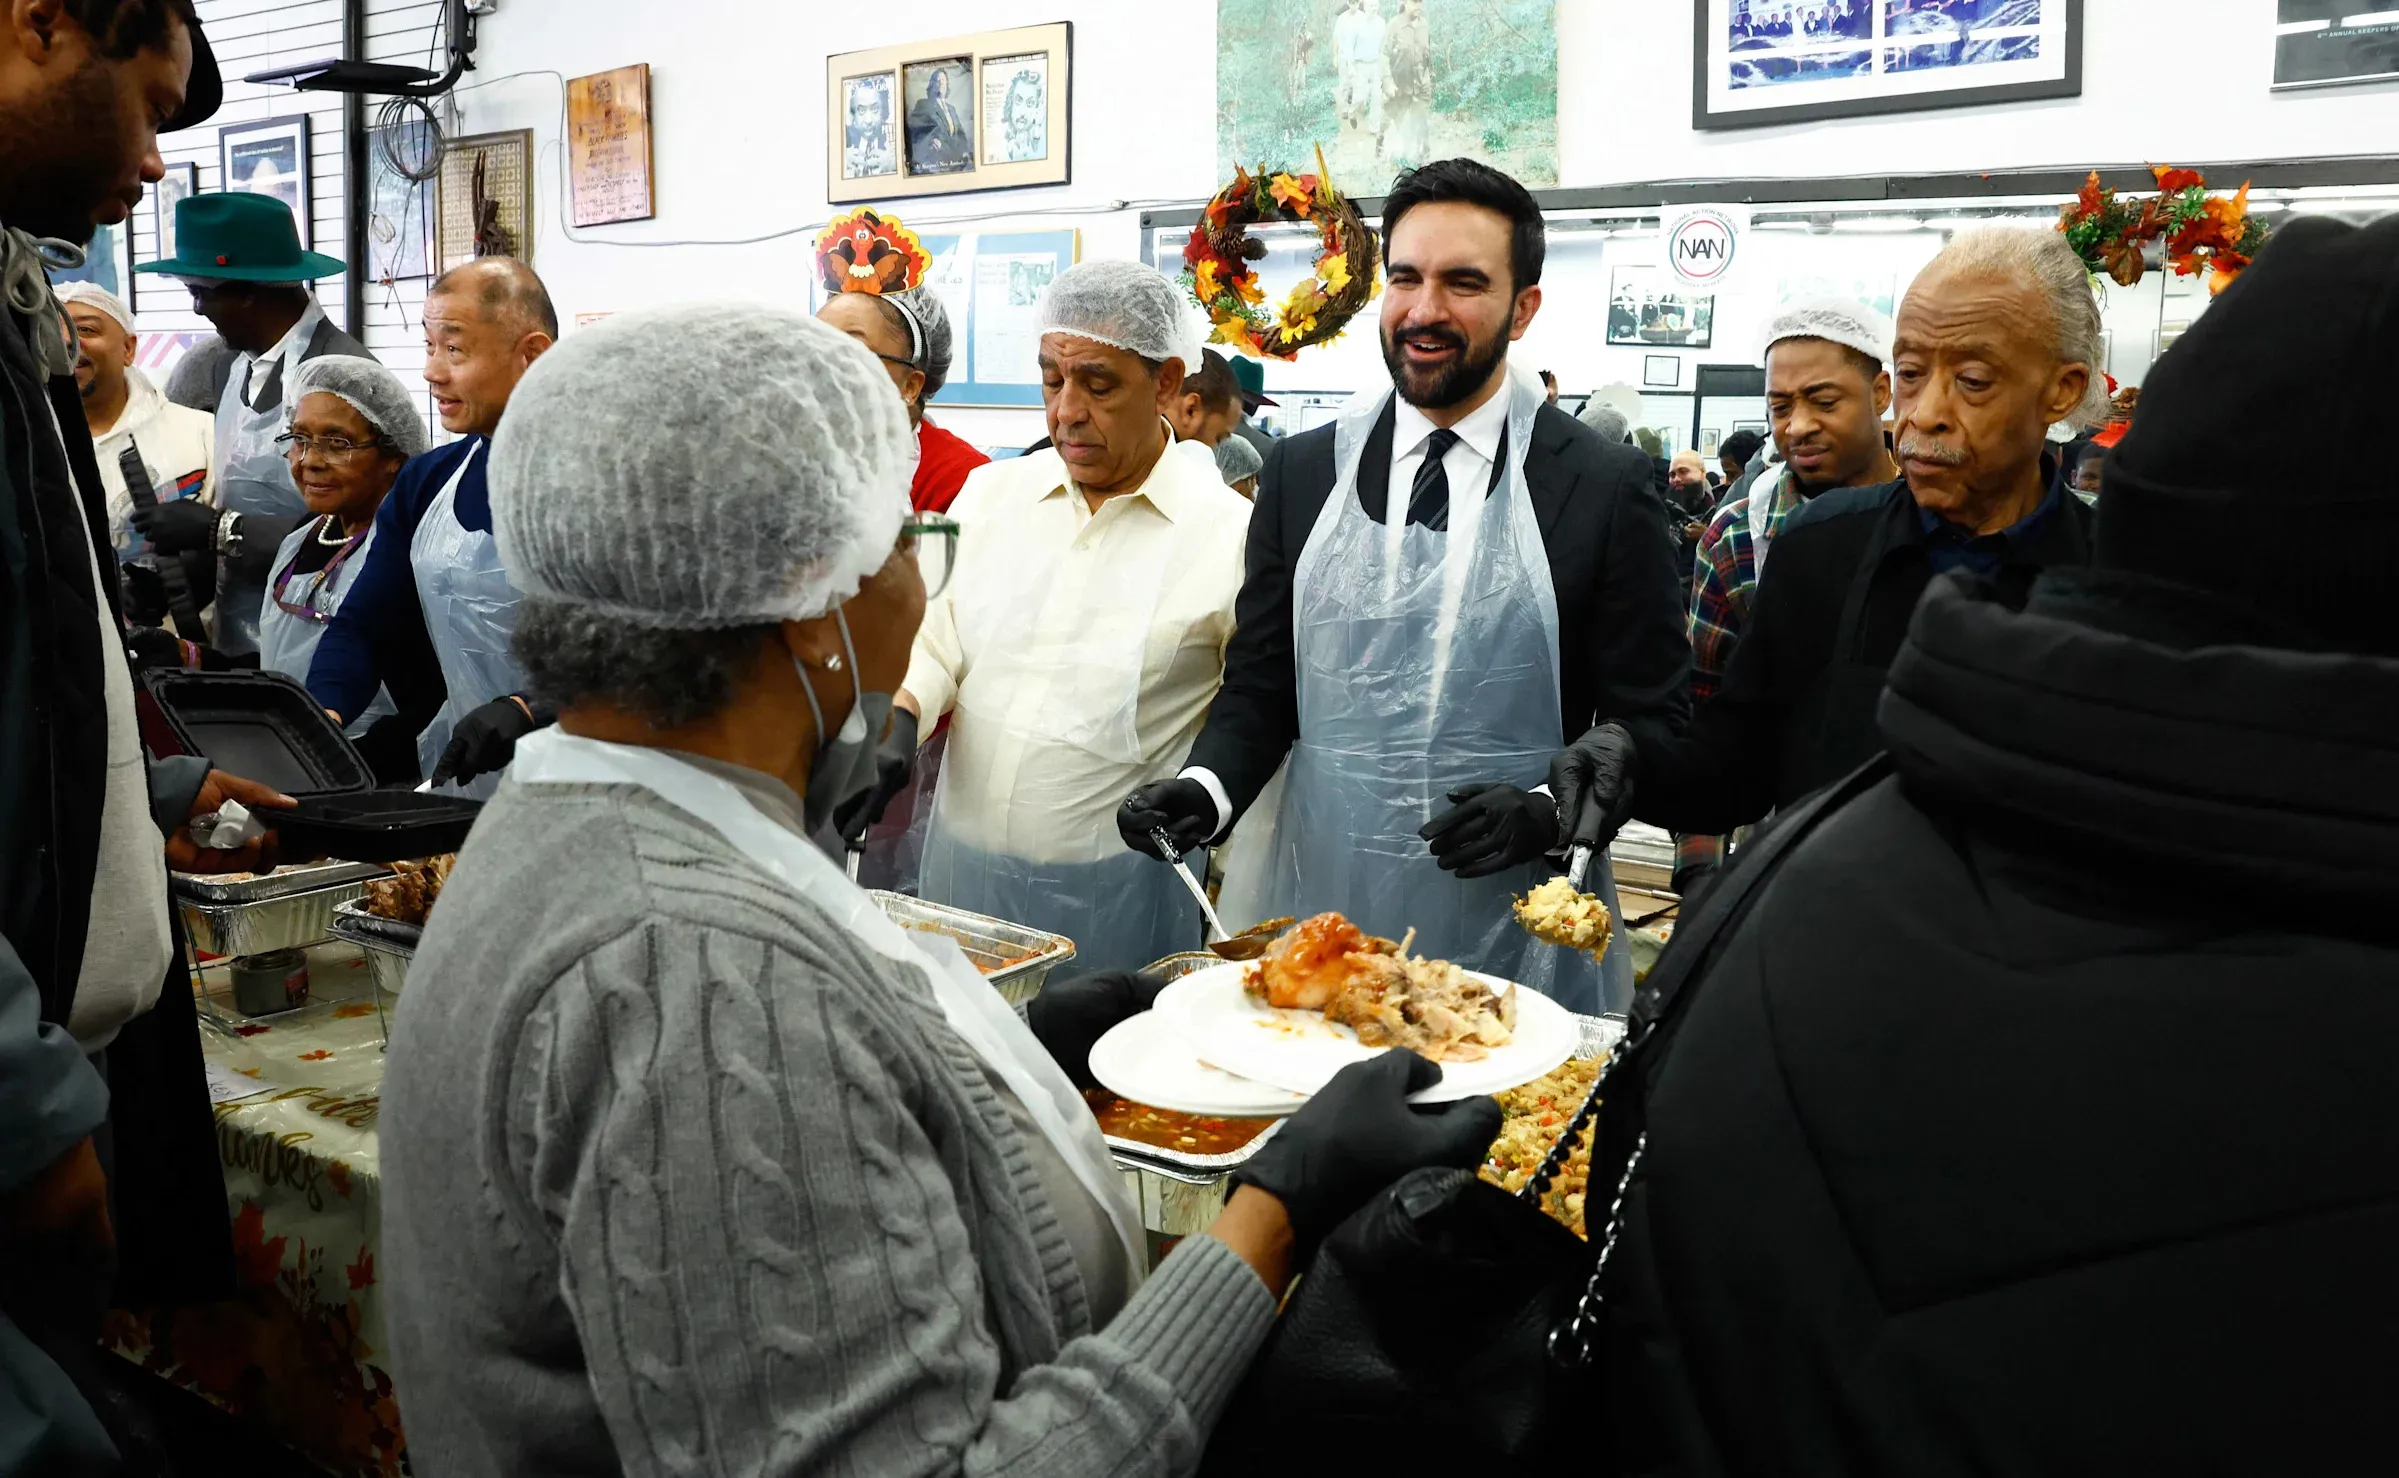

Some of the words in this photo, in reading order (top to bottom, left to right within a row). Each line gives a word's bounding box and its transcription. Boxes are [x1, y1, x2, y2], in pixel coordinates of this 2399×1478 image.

[2328, 30, 2356, 38] ANNUAL
[2358, 26, 2389, 34] KEEPERS
[1667, 213, 1690, 235] NATIONAL
[1692, 208, 1716, 216] ACTION
[1716, 211, 1739, 235] NETWORK
[1679, 238, 1725, 260] NAN
